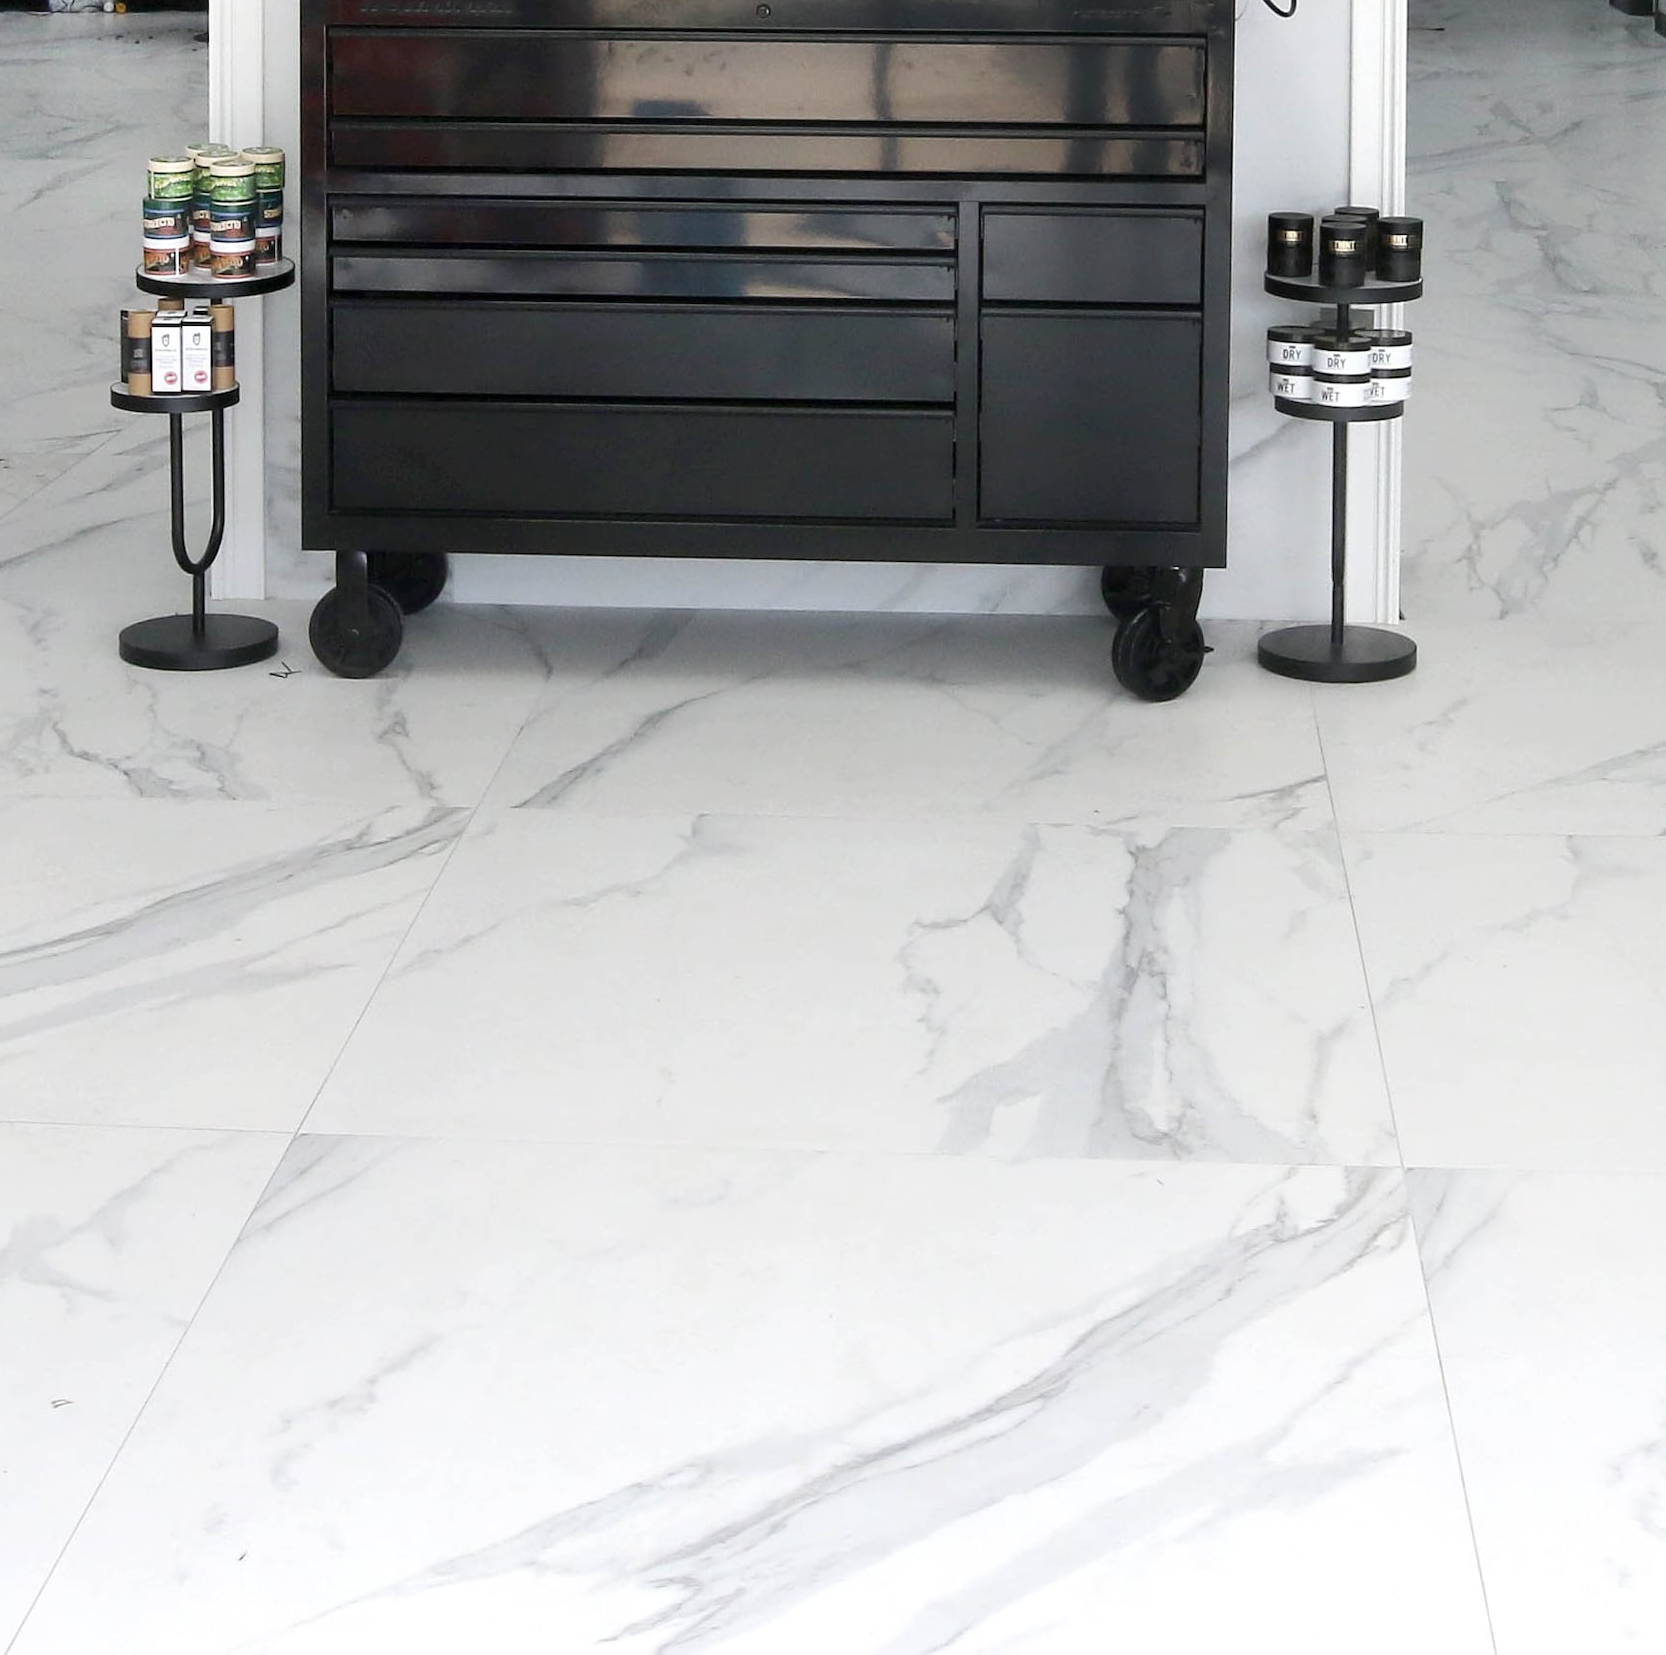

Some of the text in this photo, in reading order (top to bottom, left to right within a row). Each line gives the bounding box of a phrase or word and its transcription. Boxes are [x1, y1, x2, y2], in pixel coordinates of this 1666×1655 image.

[1282, 348, 1302, 360] DRY
[1372, 352, 1391, 364] DRY
[1327, 356, 1347, 369] DRY
[1277, 382, 1296, 394] WET
[1321, 390, 1340, 403] WET
